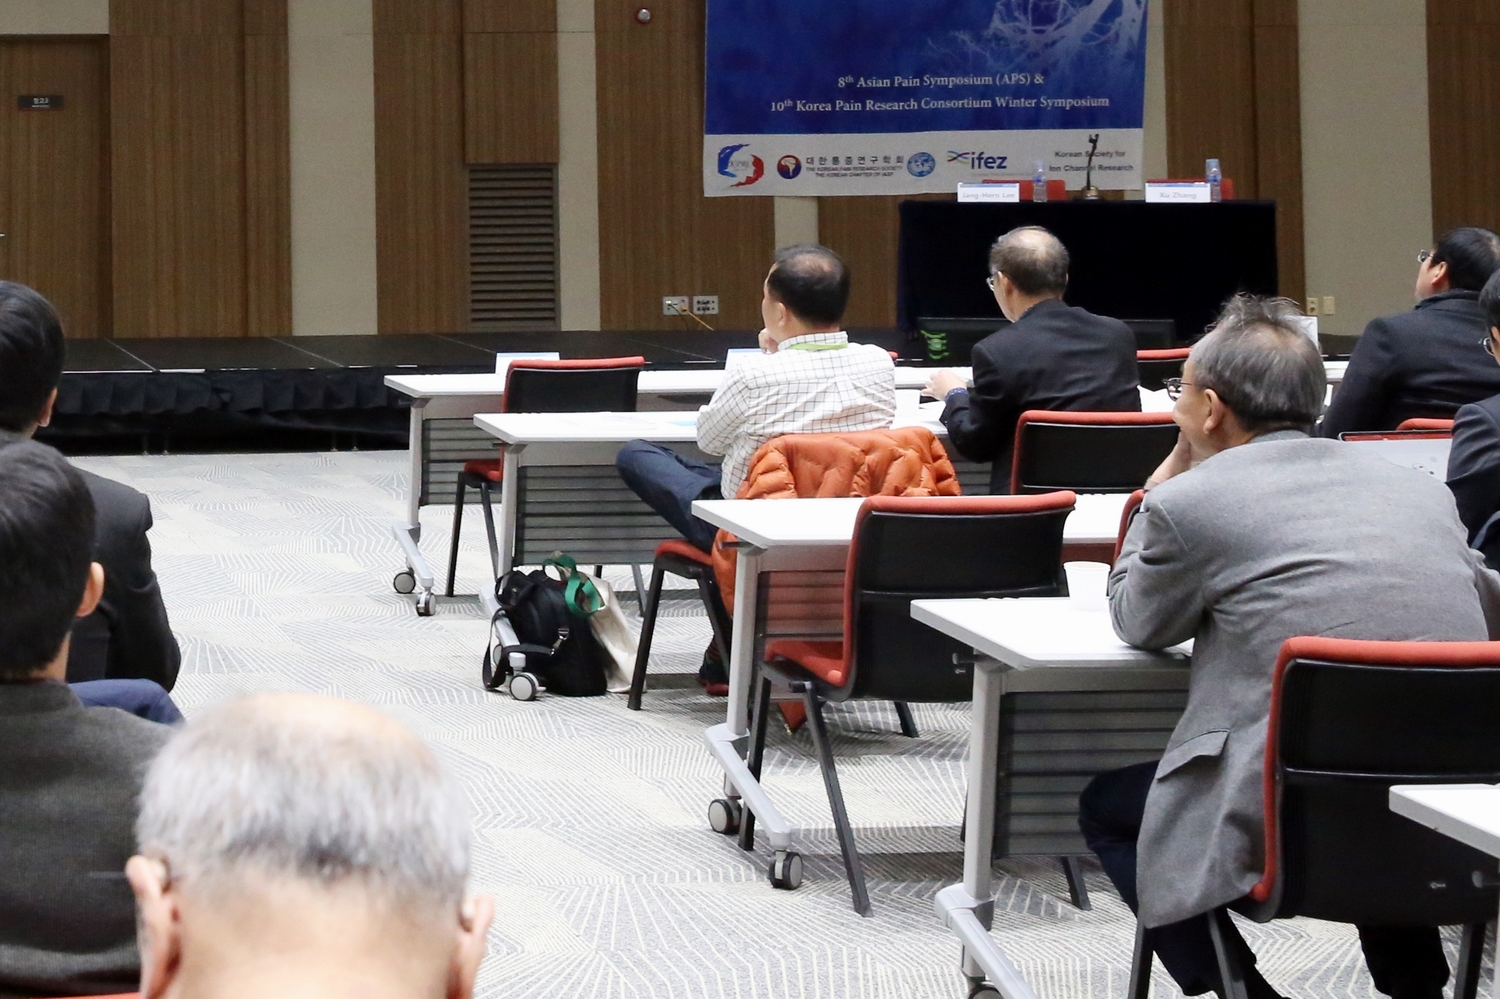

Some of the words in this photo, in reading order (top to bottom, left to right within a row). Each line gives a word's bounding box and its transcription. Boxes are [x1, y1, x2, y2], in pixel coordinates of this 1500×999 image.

[838, 75, 854, 88] 8th
[857, 76, 890, 87] Asian
[893, 75, 921, 87] Pain
[923, 74, 993, 89] Symposium
[996, 73, 1031, 87] (APS)
[1034, 73, 1044, 84] &
[771, 99, 793, 111] 10th
[796, 100, 832, 112] Korea
[835, 99, 862, 111] Pain
[866, 99, 918, 110] Research
[921, 97, 992, 109] Consortium
[995, 96, 1037, 108] Winter
[1040, 96, 1109, 110] Symposium
[971, 151, 1007, 169] ifez
[1085, 151, 1113, 159] Sciety
[1098, 164, 1134, 172] Research
